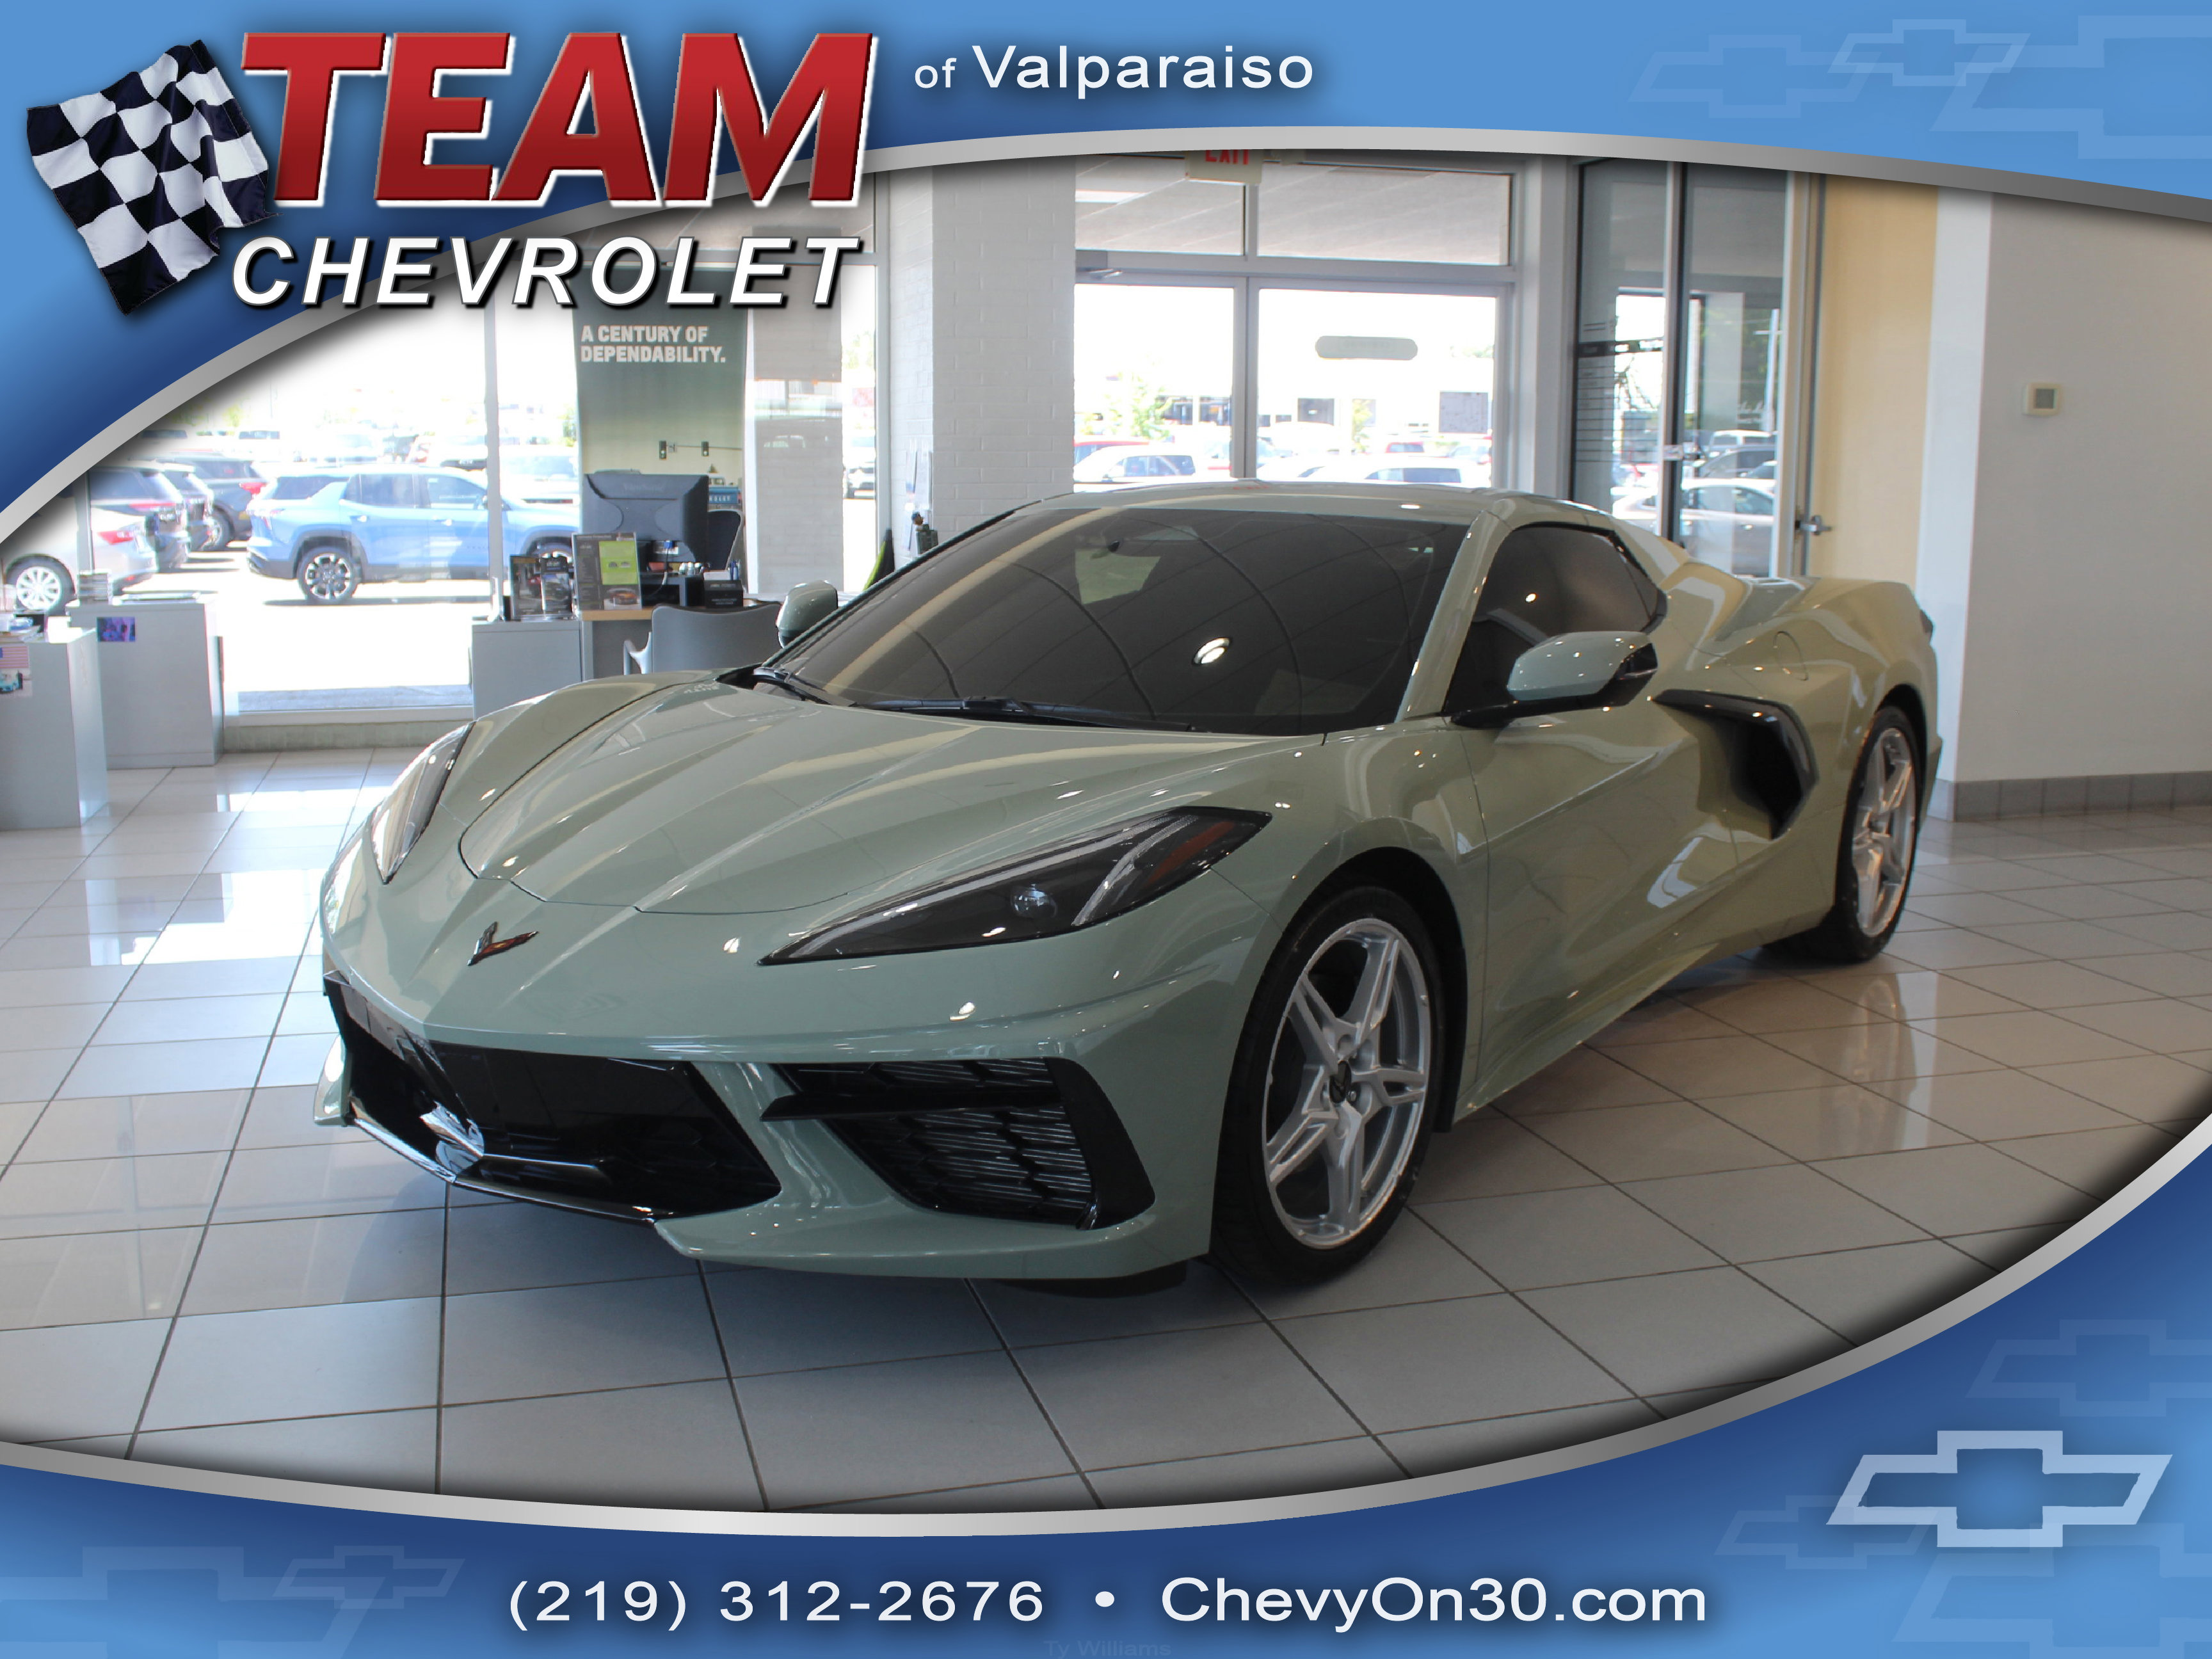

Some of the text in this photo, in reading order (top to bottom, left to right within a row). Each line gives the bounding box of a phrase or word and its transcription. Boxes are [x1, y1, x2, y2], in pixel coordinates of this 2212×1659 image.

[581, 325, 709, 343] A CENTURY OF
[581, 345, 726, 363] DEPENDABILITY.
